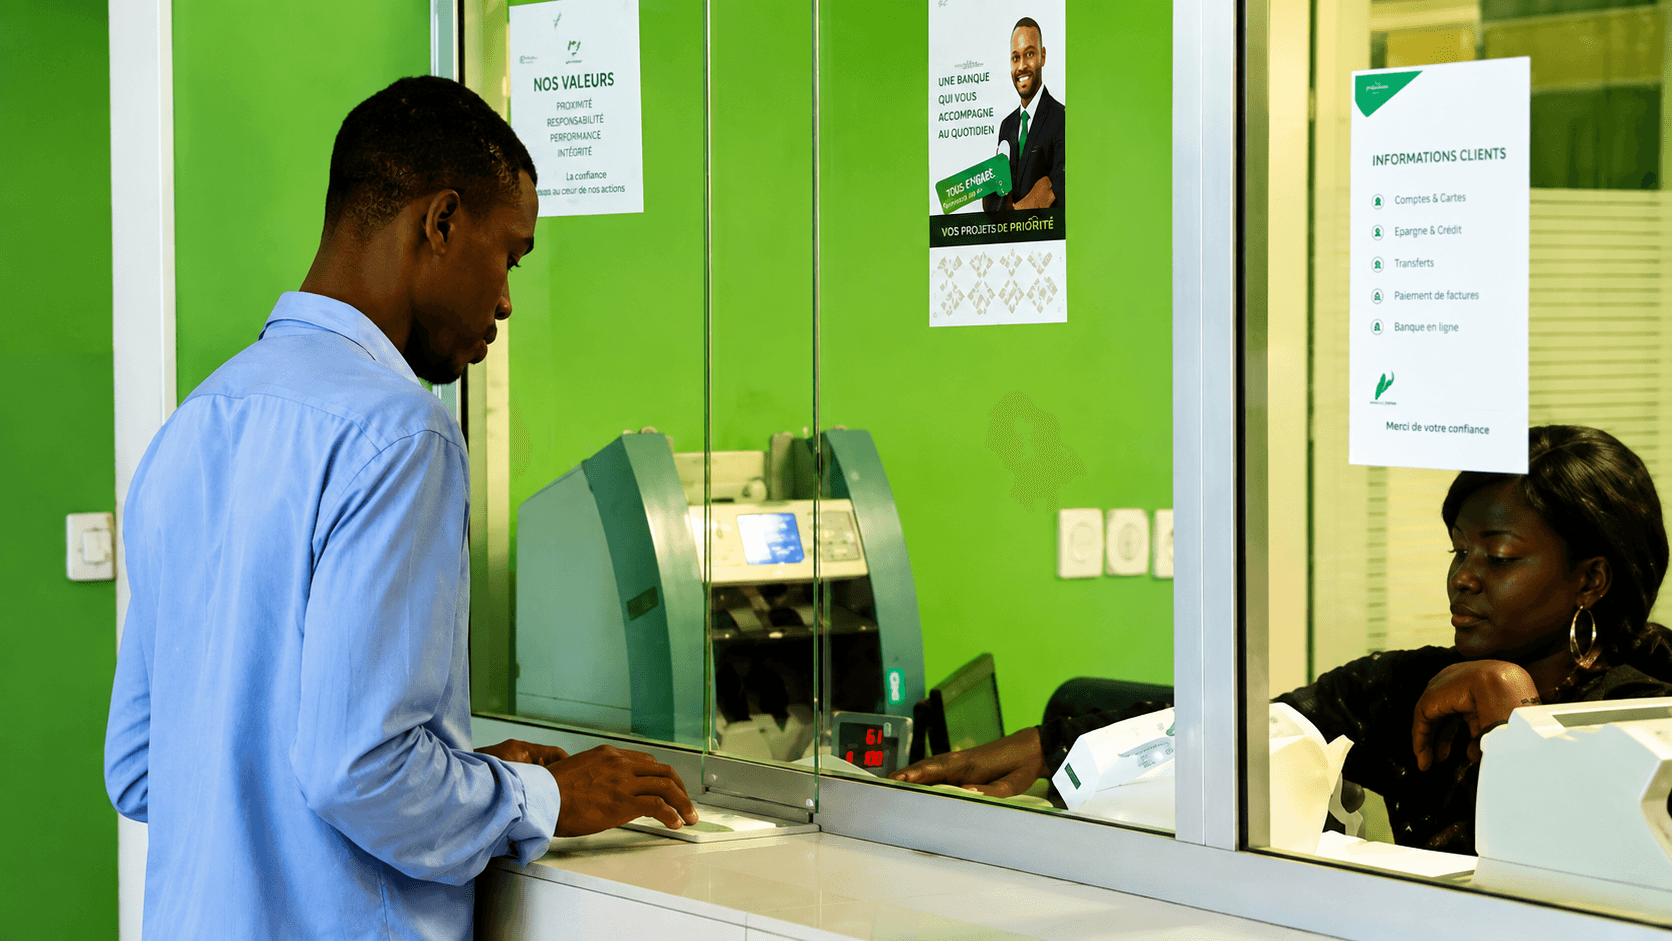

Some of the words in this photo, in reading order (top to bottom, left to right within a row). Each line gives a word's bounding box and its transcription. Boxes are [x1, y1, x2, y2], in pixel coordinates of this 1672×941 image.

[533, 76, 559, 92] NOS
[561, 72, 614, 90] VALEURS
[938, 76, 955, 87] UNE
[957, 72, 990, 84] BANQUE
[556, 97, 593, 111] PROXIMITÉ
[938, 95, 953, 106] QUI
[954, 92, 977, 103] VOUS
[547, 113, 604, 127] RESPONSABILITÉ
[938, 107, 994, 122] ACCOMPAGNE
[550, 130, 601, 142] PERFORMANCE
[938, 130, 950, 139] AU
[951, 125, 995, 140] QUOTIDIEN
[557, 146, 592, 158] INTÉGRITÉ
[1372, 149, 1457, 166] INFORMATIONS
[1460, 147, 1507, 162] CLIENTS
[566, 172, 574, 181] La
[578, 186, 587, 195] de
[588, 186, 600, 194] nos
[601, 184, 625, 193] actions
[946, 182, 965, 197] TOUS
[1394, 195, 1431, 207] Comptes
[1432, 193, 1439, 203] &
[1440, 192, 1467, 203] Cartes
[941, 226, 960, 237] VOS
[961, 224, 997, 236] PROJETS
[997, 222, 1009, 233] DE
[1010, 216, 1054, 232] PRIORITÉ
[1394, 226, 1428, 238] Epargne
[1429, 225, 1436, 235] &
[1437, 225, 1463, 235] Crédit
[1394, 257, 1435, 269] Transferts
[1394, 290, 1433, 300] Paiement
[1434, 290, 1445, 300] de
[1446, 289, 1480, 300] factures
[1394, 321, 1425, 334] Banque
[1426, 323, 1437, 332] en
[1438, 321, 1459, 334] ligne
[1386, 421, 1410, 431] Merci
[1411, 422, 1422, 432] de
[1424, 423, 1447, 433] votre
[1448, 424, 1490, 435] confiance
[866, 729, 883, 745] 61
